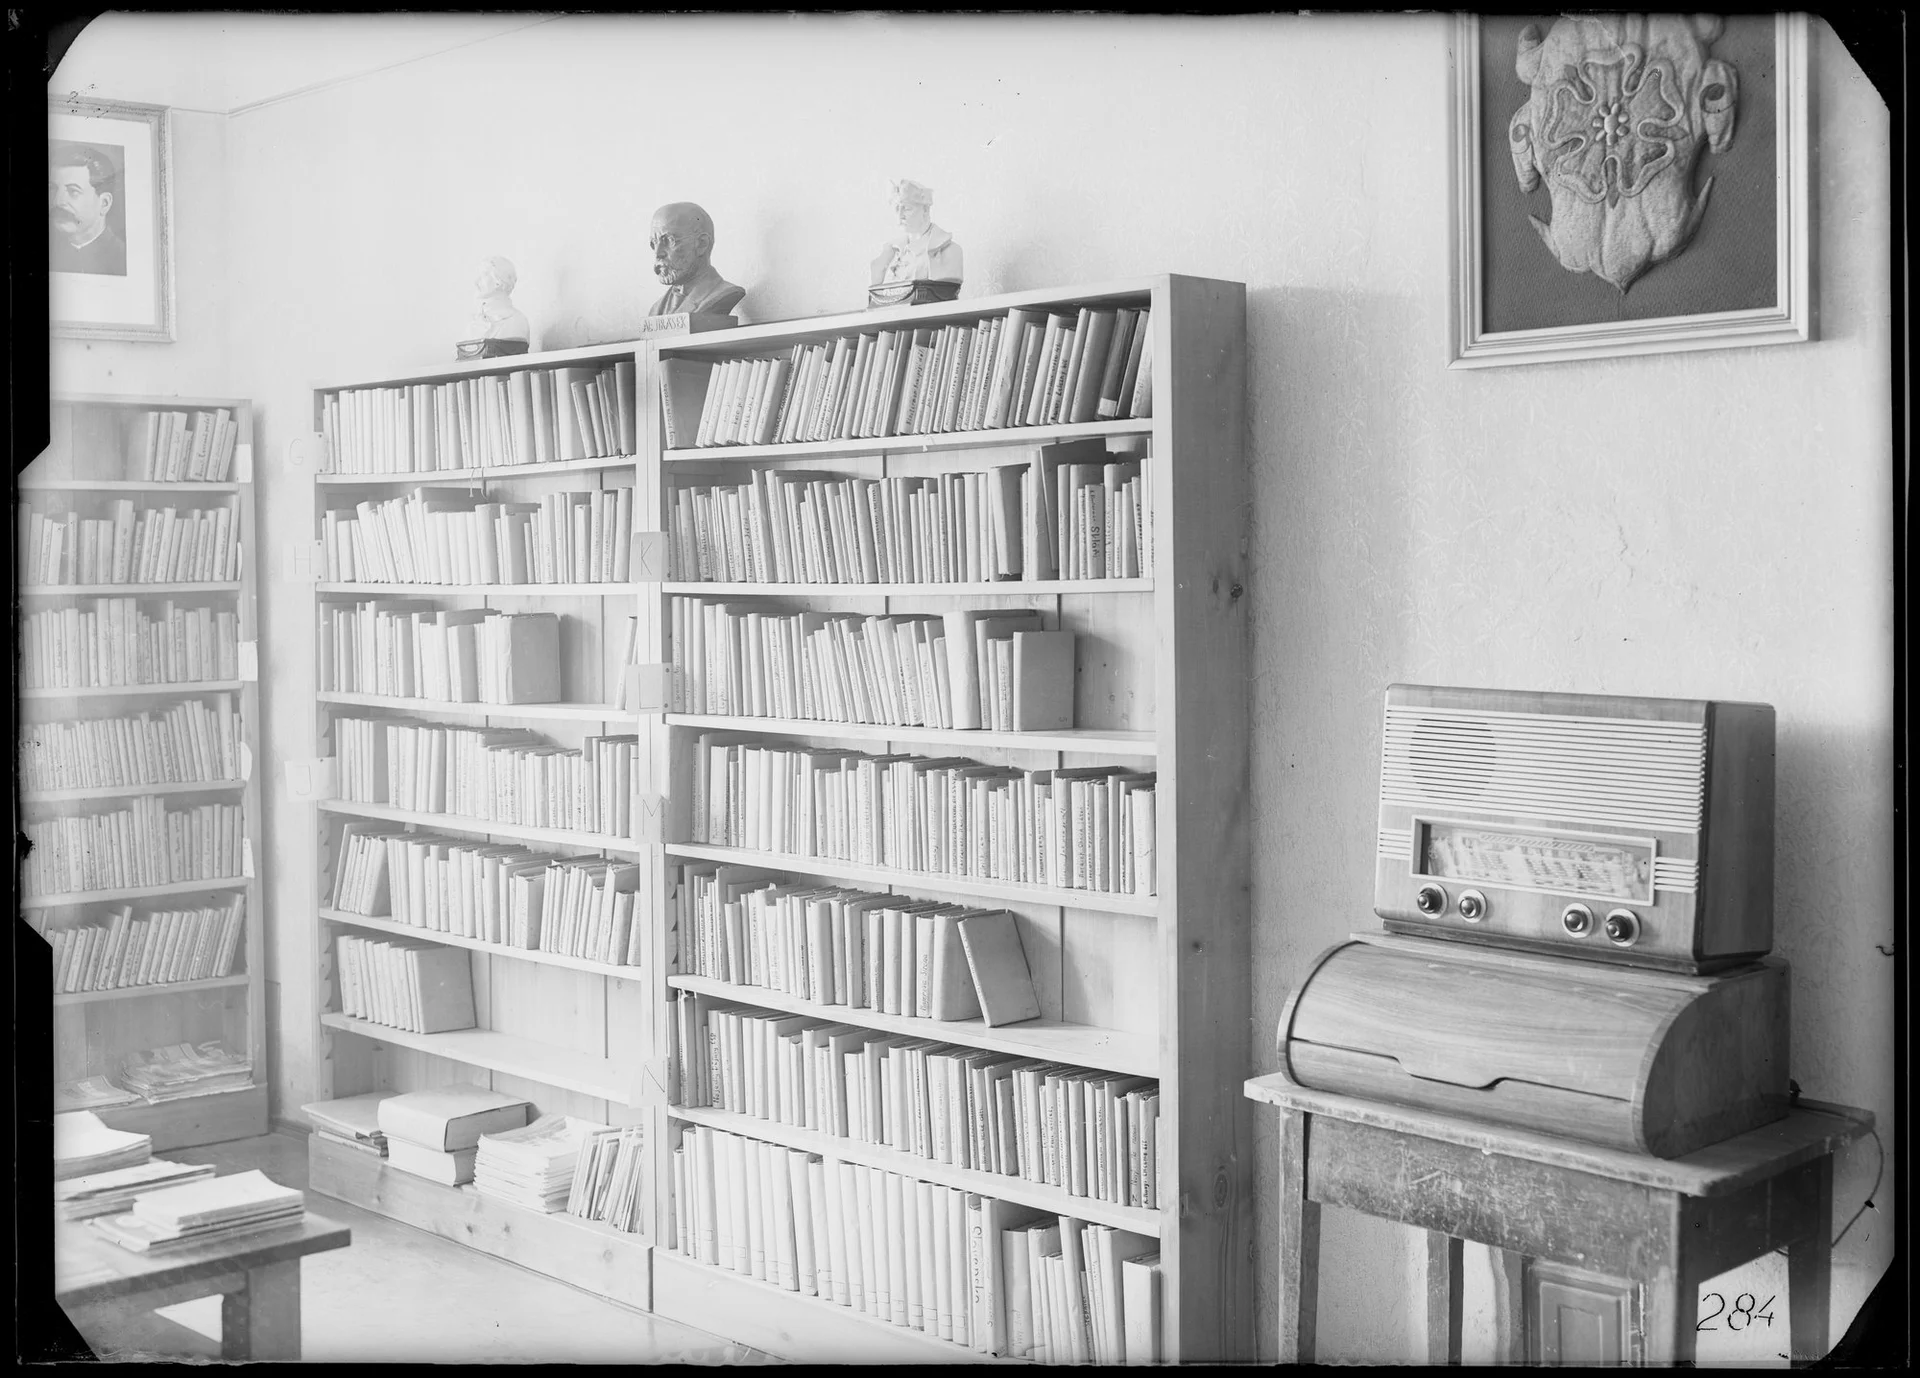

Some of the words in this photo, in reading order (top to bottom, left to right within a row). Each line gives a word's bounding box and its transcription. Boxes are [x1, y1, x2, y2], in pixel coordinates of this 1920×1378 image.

[289, 438, 304, 466] G
[293, 544, 312, 576] H
[640, 539, 653, 577] K
[638, 671, 660, 710] L
[641, 798, 665, 837] M
[641, 1060, 666, 1097] N
[1696, 1292, 1776, 1331] 284
